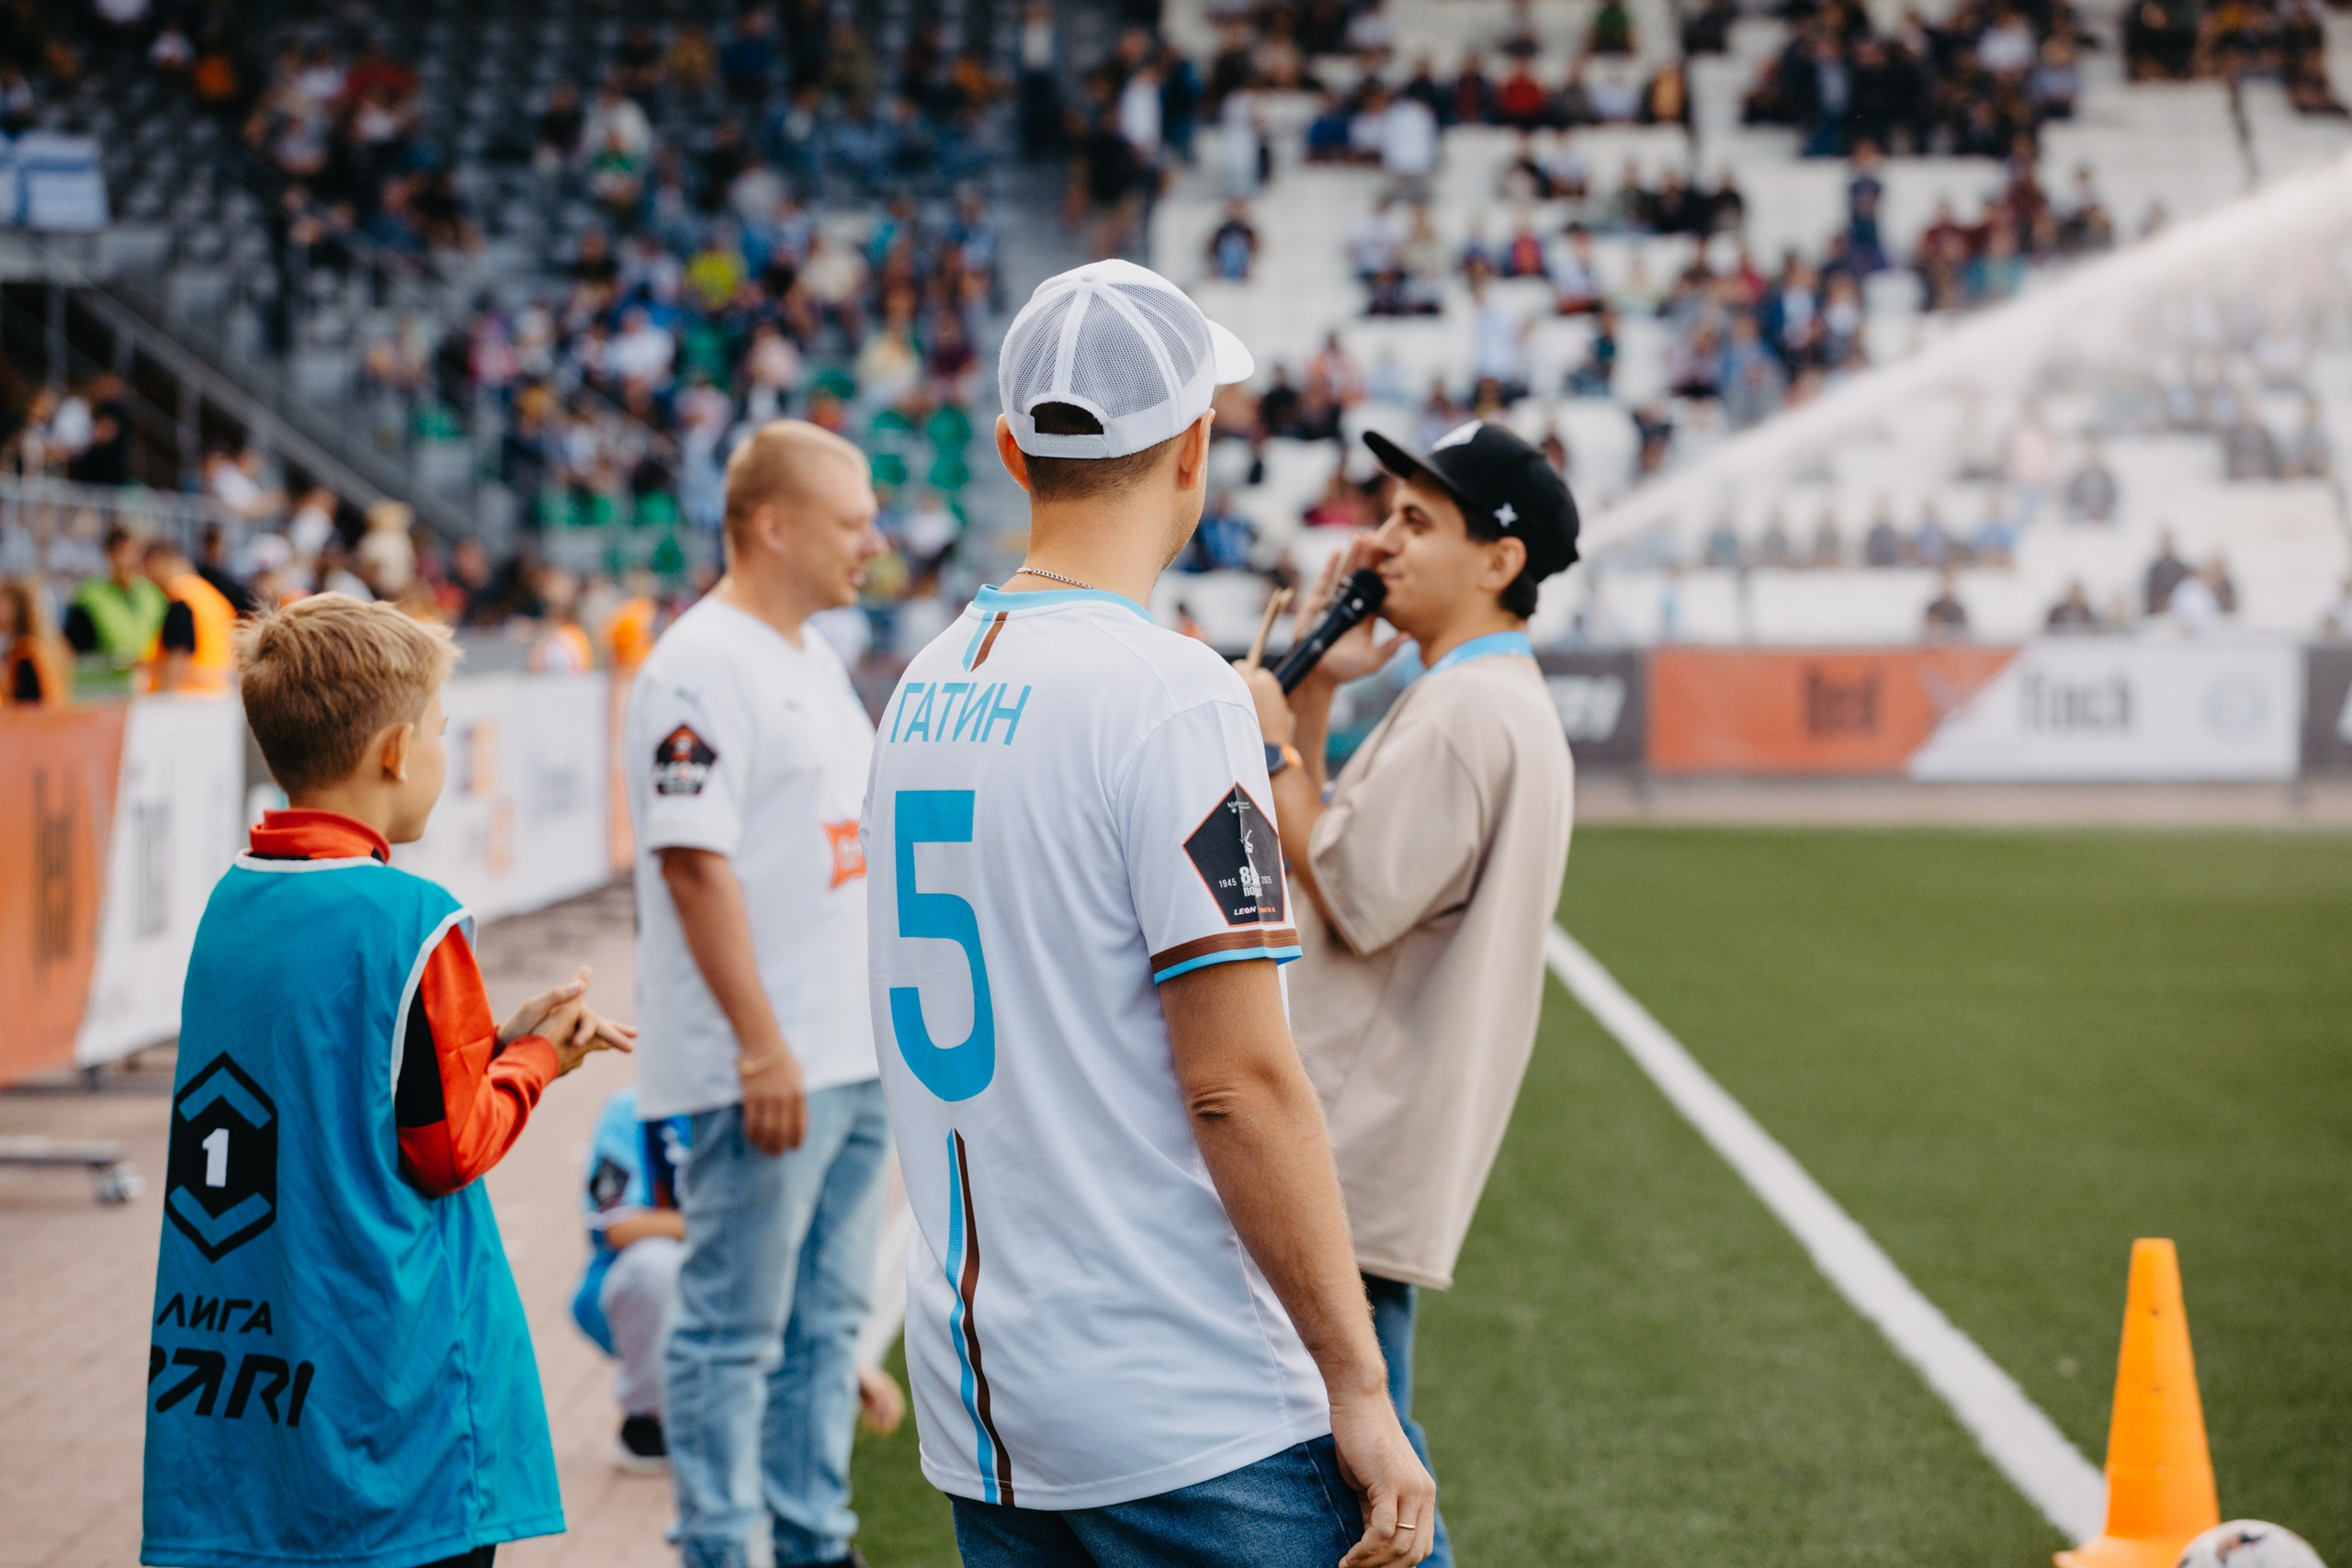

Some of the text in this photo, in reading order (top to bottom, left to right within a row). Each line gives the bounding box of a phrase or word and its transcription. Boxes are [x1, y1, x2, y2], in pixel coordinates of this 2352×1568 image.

[889, 682, 1032, 746] ГАТИН
[1218, 878, 1238, 888] 1945
[1234, 906, 1256, 916] LEON
[889, 790, 995, 1102] 5
[202, 1128, 230, 1188] 1
[155, 1292, 273, 1336] ЛИГА
